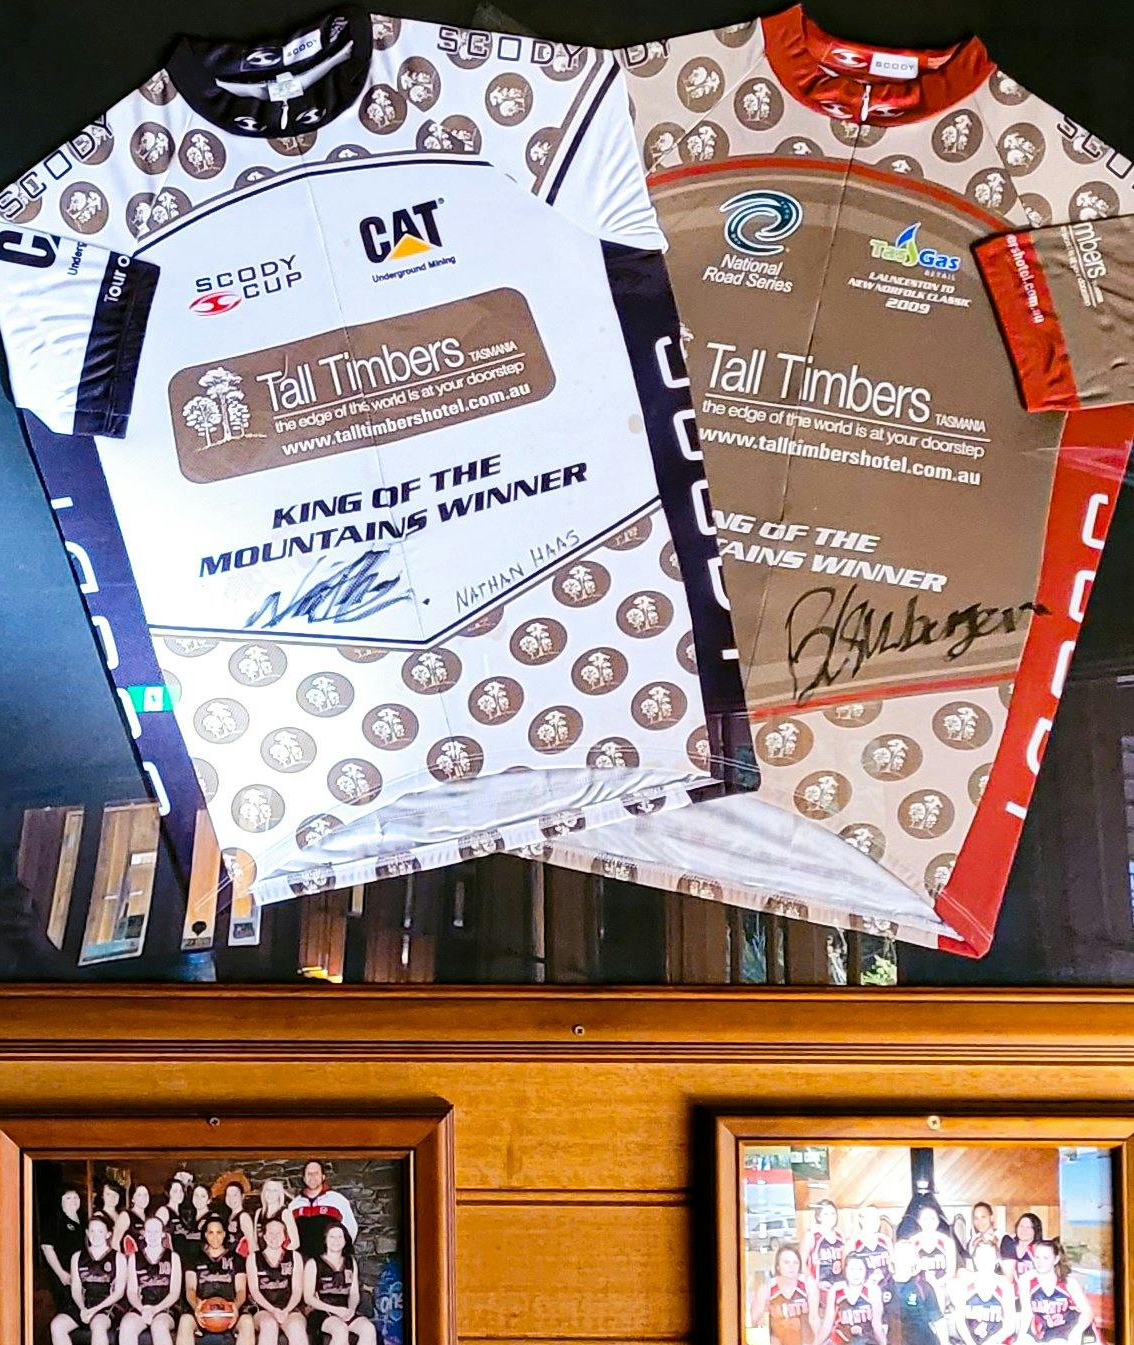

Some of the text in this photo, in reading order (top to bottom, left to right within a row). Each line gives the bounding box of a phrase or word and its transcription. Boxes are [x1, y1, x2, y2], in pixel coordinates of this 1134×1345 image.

[437, 27, 583, 68] SCODY
[195, 254, 297, 294] SCODY
[372, 255, 457, 284] Underground Mining
[702, 265, 794, 293] Road Series
[720, 253, 783, 277] National
[868, 271, 956, 295] LAUNCESTON TO
[103, 269, 127, 303] Tour
[243, 271, 302, 300] CUP
[848, 276, 972, 308] NEW NORFOLK CLASSIC
[885, 297, 931, 315] 2009
[256, 338, 519, 412] Tall Timbers TASMANIA
[707, 341, 986, 434] Tall Timbers TASMANIA
[275, 359, 526, 434] the edge of the world is at your doorstep
[281, 382, 531, 456] www.talltimbershotel.com.au
[702, 400, 985, 460] the edge of the world is at your doorstep
[699, 426, 982, 486] www.talltimbershotel.com.au
[272, 454, 502, 530] KING OF THE
[198, 461, 588, 578] MOUNTAINS WINNER
[758, 521, 810, 543] OF
[815, 526, 881, 554] THE
[455, 528, 580, 613] NATHAN HAAS
[811, 554, 949, 593] WINNER
